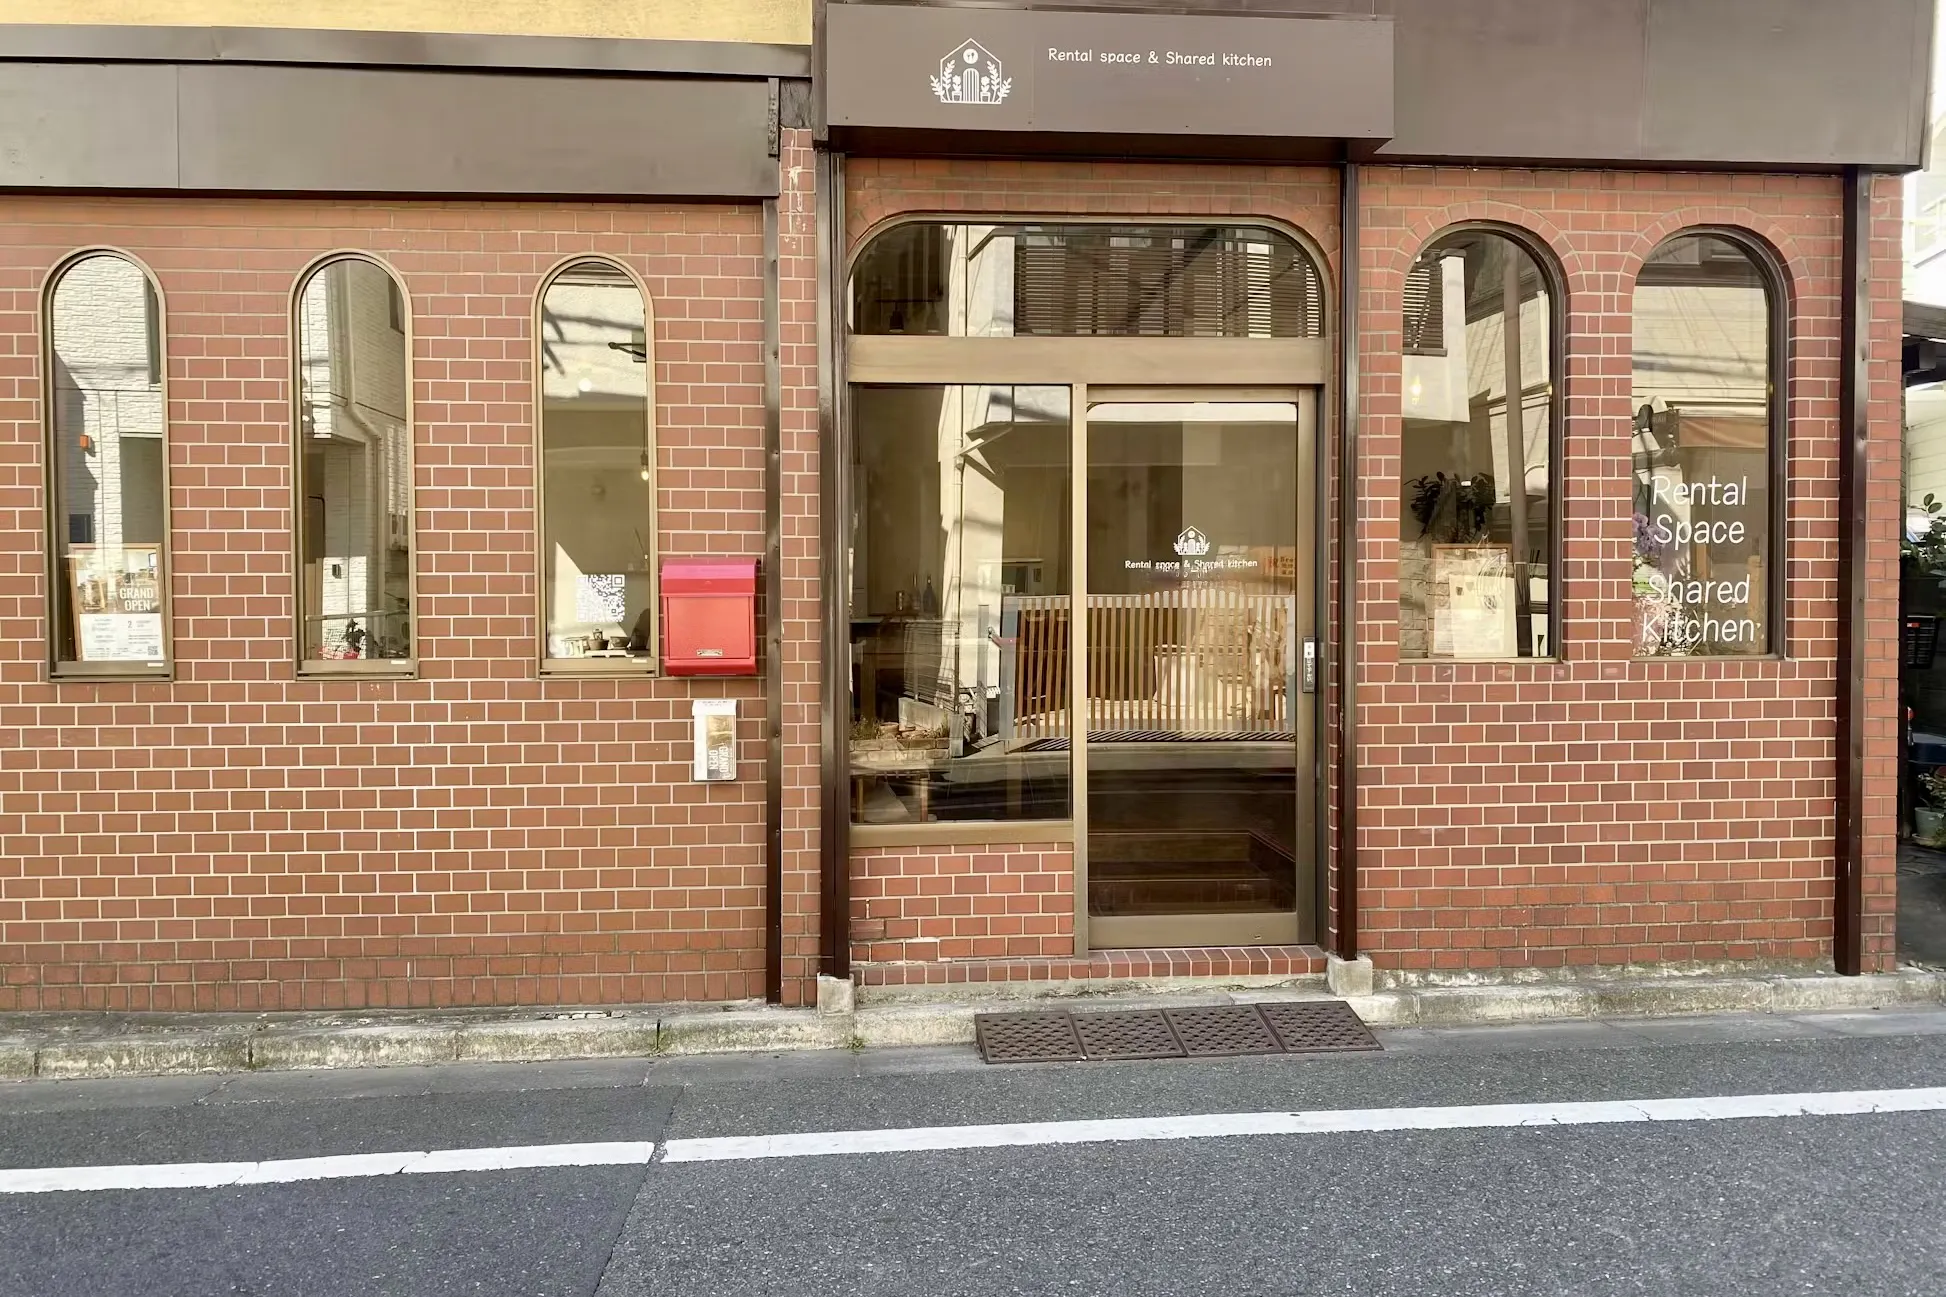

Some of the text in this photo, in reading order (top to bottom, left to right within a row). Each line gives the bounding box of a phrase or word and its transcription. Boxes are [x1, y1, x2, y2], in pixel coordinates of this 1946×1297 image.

[1048, 47, 1272, 67] Rental space & Shared kitchen
[1650, 475, 1748, 506] Rental
[1653, 514, 1745, 551] Space
[1125, 560, 1151, 569] Rental
[1227, 560, 1258, 569] kitchen
[119, 587, 154, 599] GRAND
[1648, 573, 1751, 604] Shared
[124, 599, 151, 611] OPEN
[1641, 612, 1755, 642] Kitchen
[708, 749, 719, 770] OPEN
[718, 746, 729, 773] GRAND
